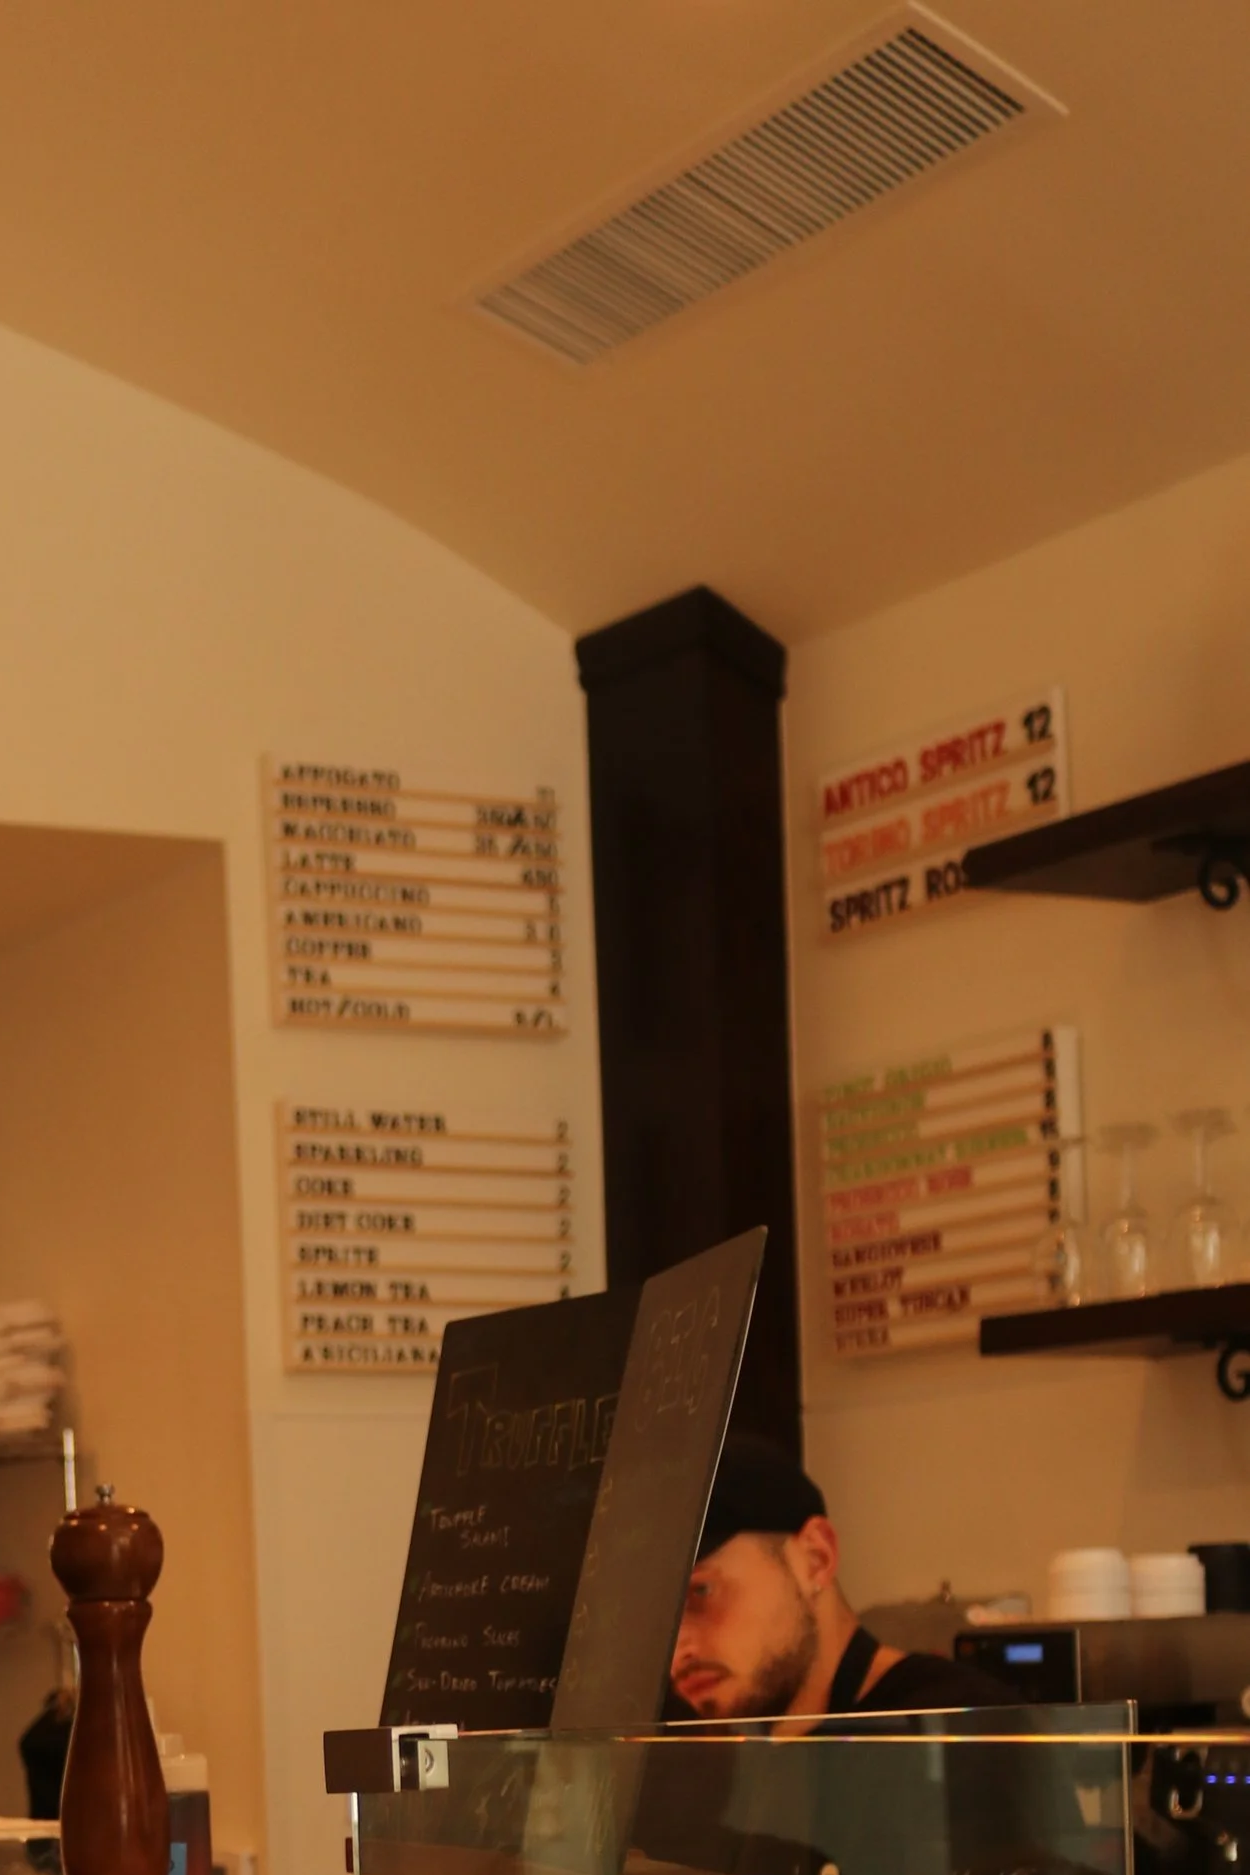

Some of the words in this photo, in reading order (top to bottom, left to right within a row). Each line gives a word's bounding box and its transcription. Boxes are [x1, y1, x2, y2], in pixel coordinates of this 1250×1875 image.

[822, 756, 908, 820] ANTICO
[919, 718, 1006, 786] SPRITZ
[829, 875, 909, 934] SPRITZ
[293, 1107, 360, 1130] STILL
[368, 1110, 446, 1134] WATER
[295, 1175, 355, 1197] COKE
[355, 1211, 415, 1233] COKE
[297, 1244, 380, 1265] SPRITE
[300, 1278, 378, 1301] LEMON
[389, 1280, 432, 1302] TEA
[302, 1312, 374, 1334] PEACH
[388, 1315, 430, 1336] TEA
